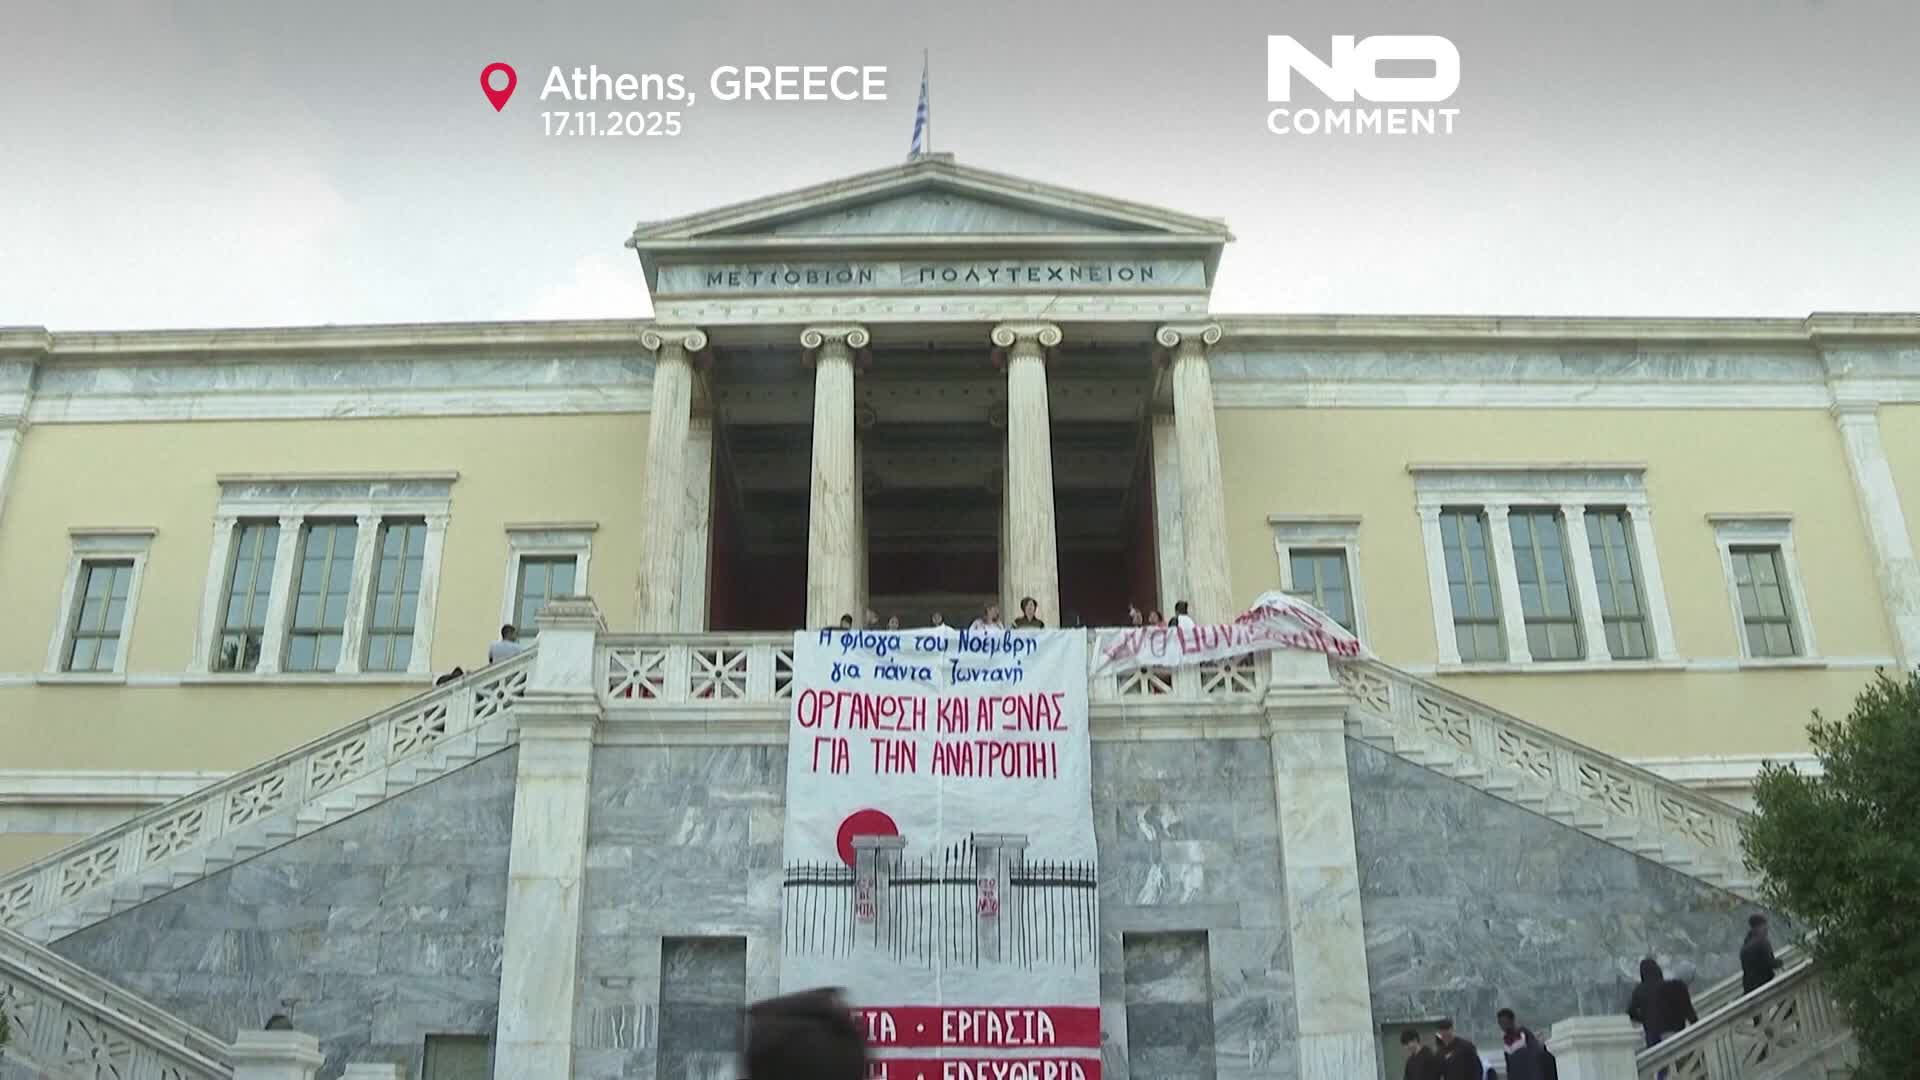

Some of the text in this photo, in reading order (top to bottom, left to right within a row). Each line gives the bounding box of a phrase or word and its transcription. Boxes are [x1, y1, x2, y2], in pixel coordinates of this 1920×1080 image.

[919, 266, 1154, 283] ΠΟΛΥΤΕΧΝΕΙΟΝ
[914, 635, 949, 652] του
[831, 656, 1024, 686] για πάντα ζωντανή
[797, 688, 1068, 734] ΟΡΓΑΝΩΣΗ ΚΑΙ ΑΓΩΝΑΣ
[812, 736, 1057, 780] ΓΙΑ ΤΗΝ ΑΝΑΤΡΟΠΗ!
[942, 1010, 1056, 1044] ΕΡΓΑΣΙΑ
